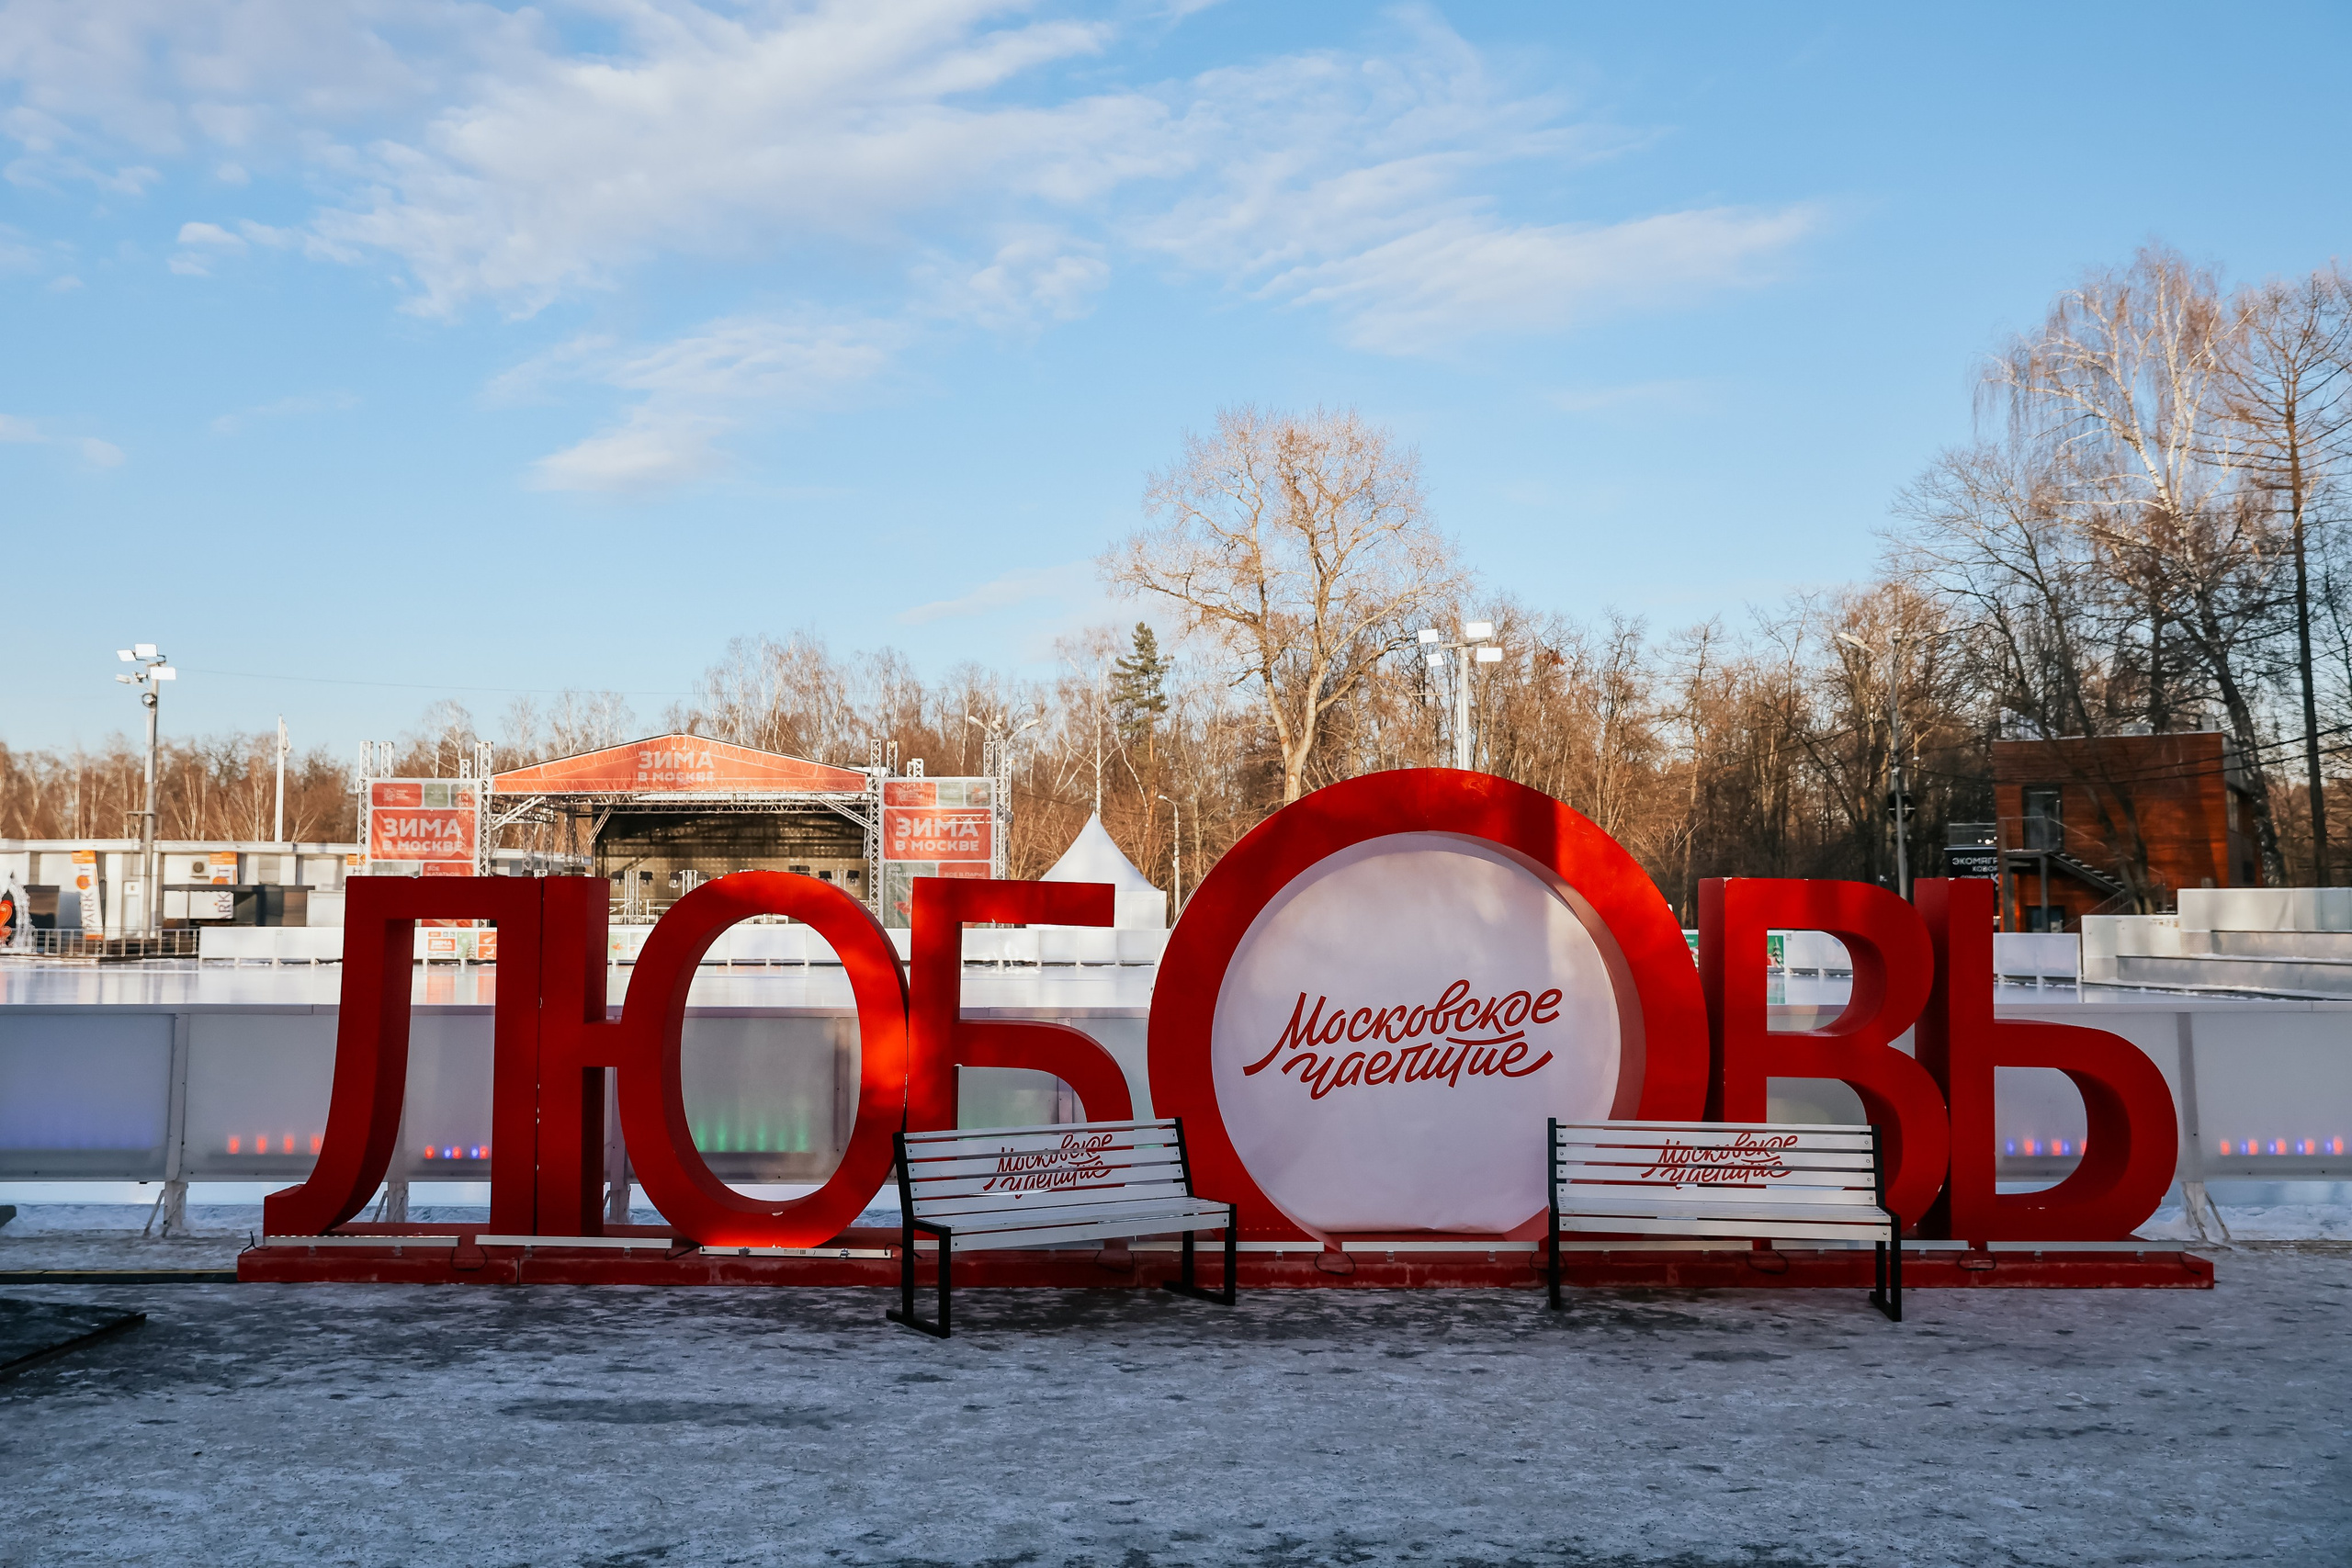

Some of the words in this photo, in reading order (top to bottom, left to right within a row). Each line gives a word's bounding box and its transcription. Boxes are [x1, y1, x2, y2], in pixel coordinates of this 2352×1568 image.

[638, 750, 715, 769] ЗИМА
[638, 772, 648, 782] В
[652, 772, 715, 782] МОСКВЕ
[382, 818, 463, 838] ЗИМА
[895, 818, 979, 838] ЗИМА
[382, 840, 393, 852] В
[397, 840, 463, 852] МОСКВЕ
[895, 840, 906, 852] В
[910, 840, 979, 852] МОСКВЕ
[264, 770, 2177, 1249] ЛЮБОВЬ
[1242, 979, 1563, 1077] Московское
[982, 1134, 1114, 1191] Московское
[1640, 1132, 1799, 1179] Московское
